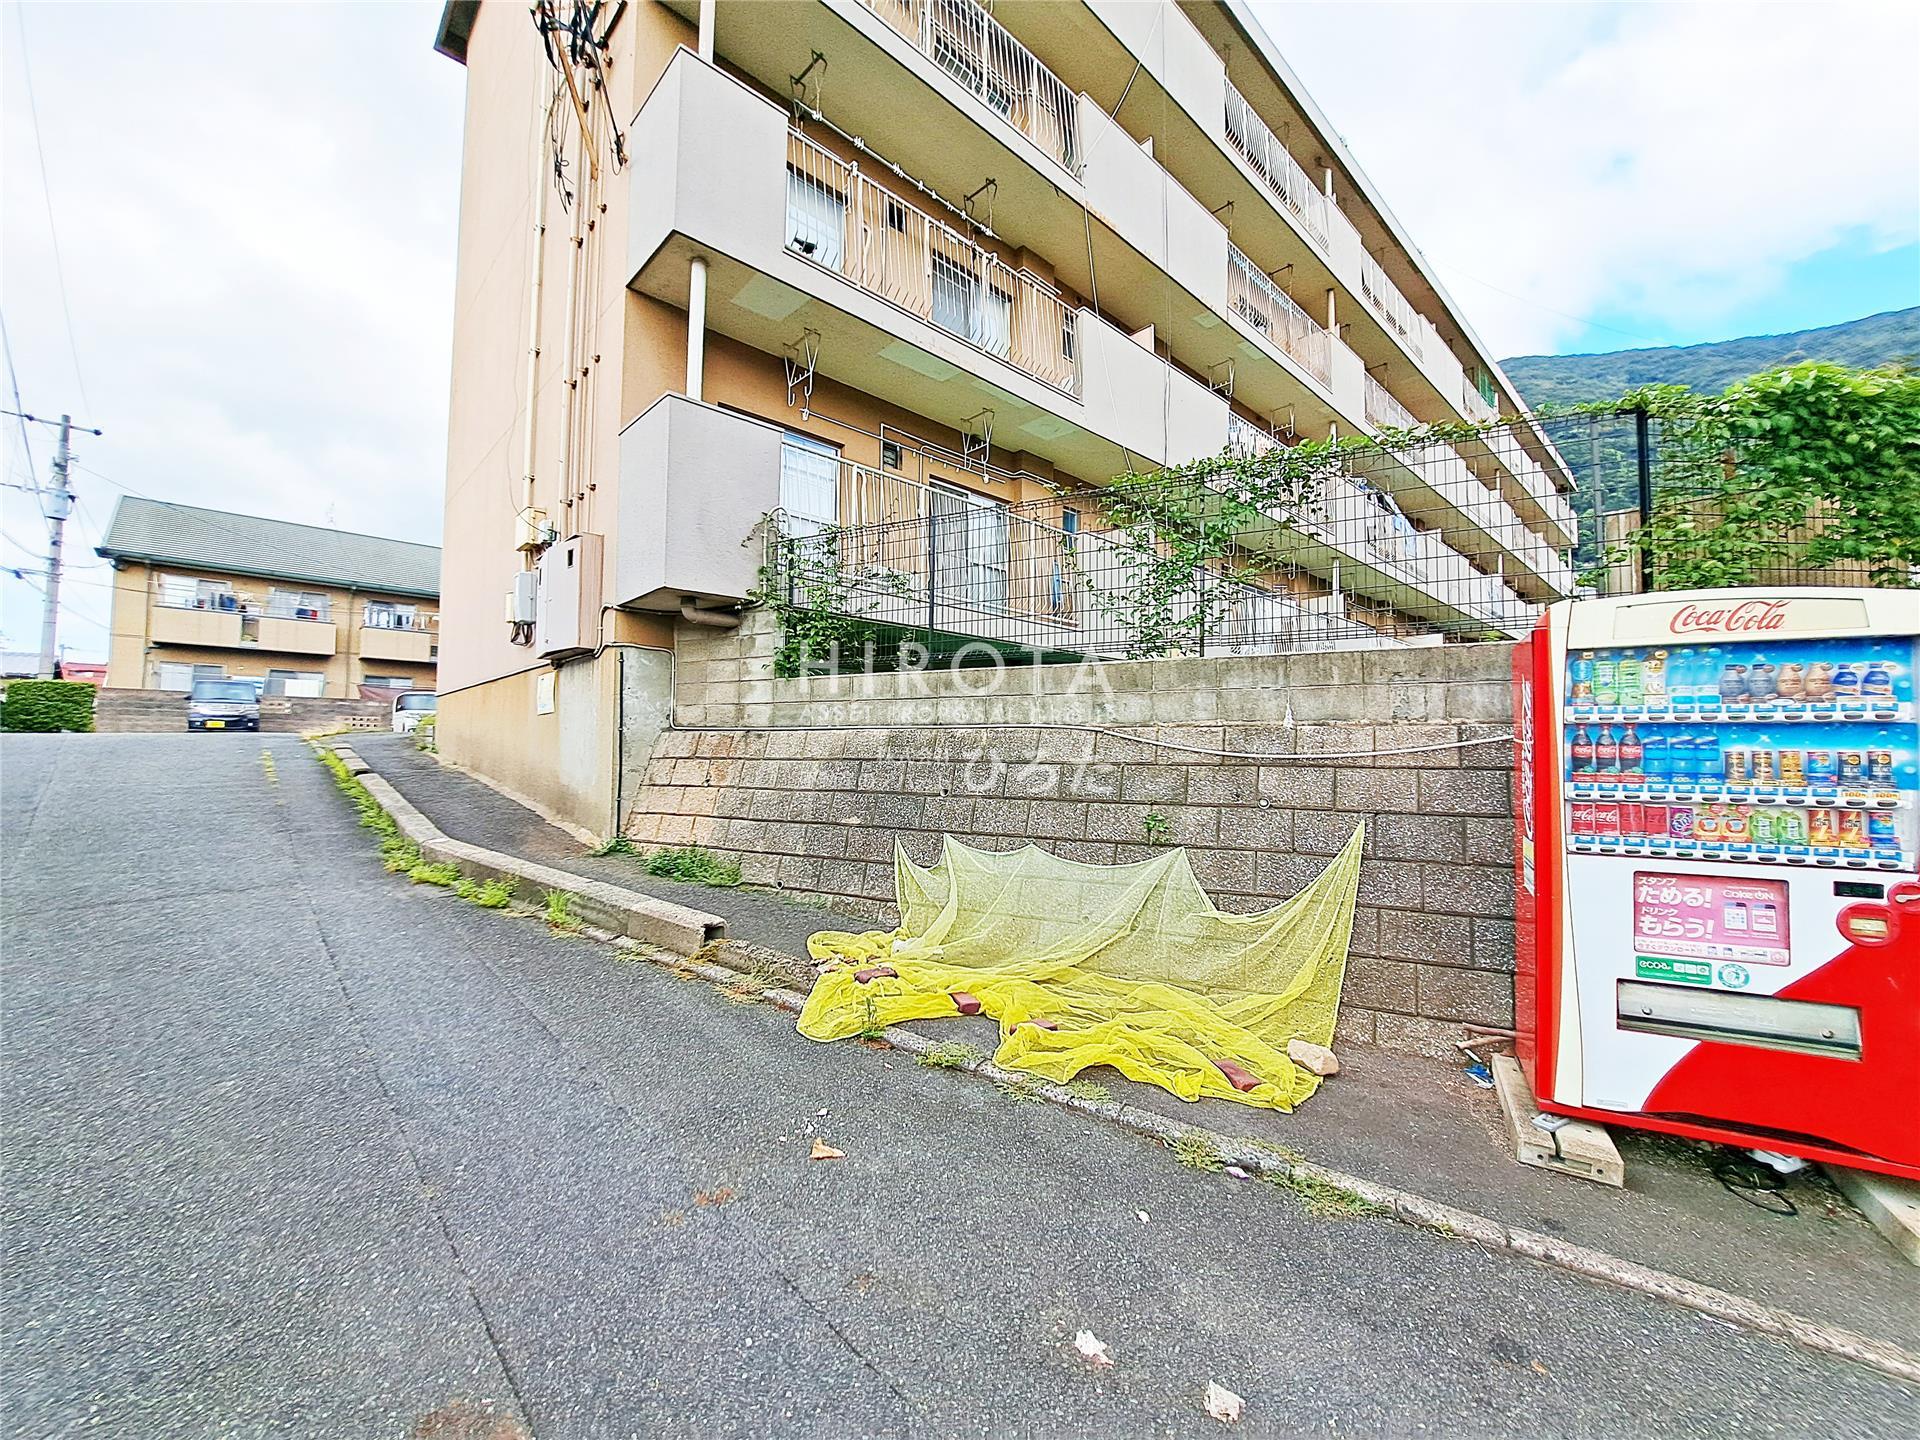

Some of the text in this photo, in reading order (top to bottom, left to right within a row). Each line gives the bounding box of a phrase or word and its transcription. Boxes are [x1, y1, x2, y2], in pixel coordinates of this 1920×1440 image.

[1669, 599, 1791, 634] Coca-Cola
[1638, 876, 1678, 885] スタンプ
[1637, 885, 1713, 909] ためる!
[1640, 906, 1679, 916] ドリンク
[1638, 914, 1715, 940] もらう!
